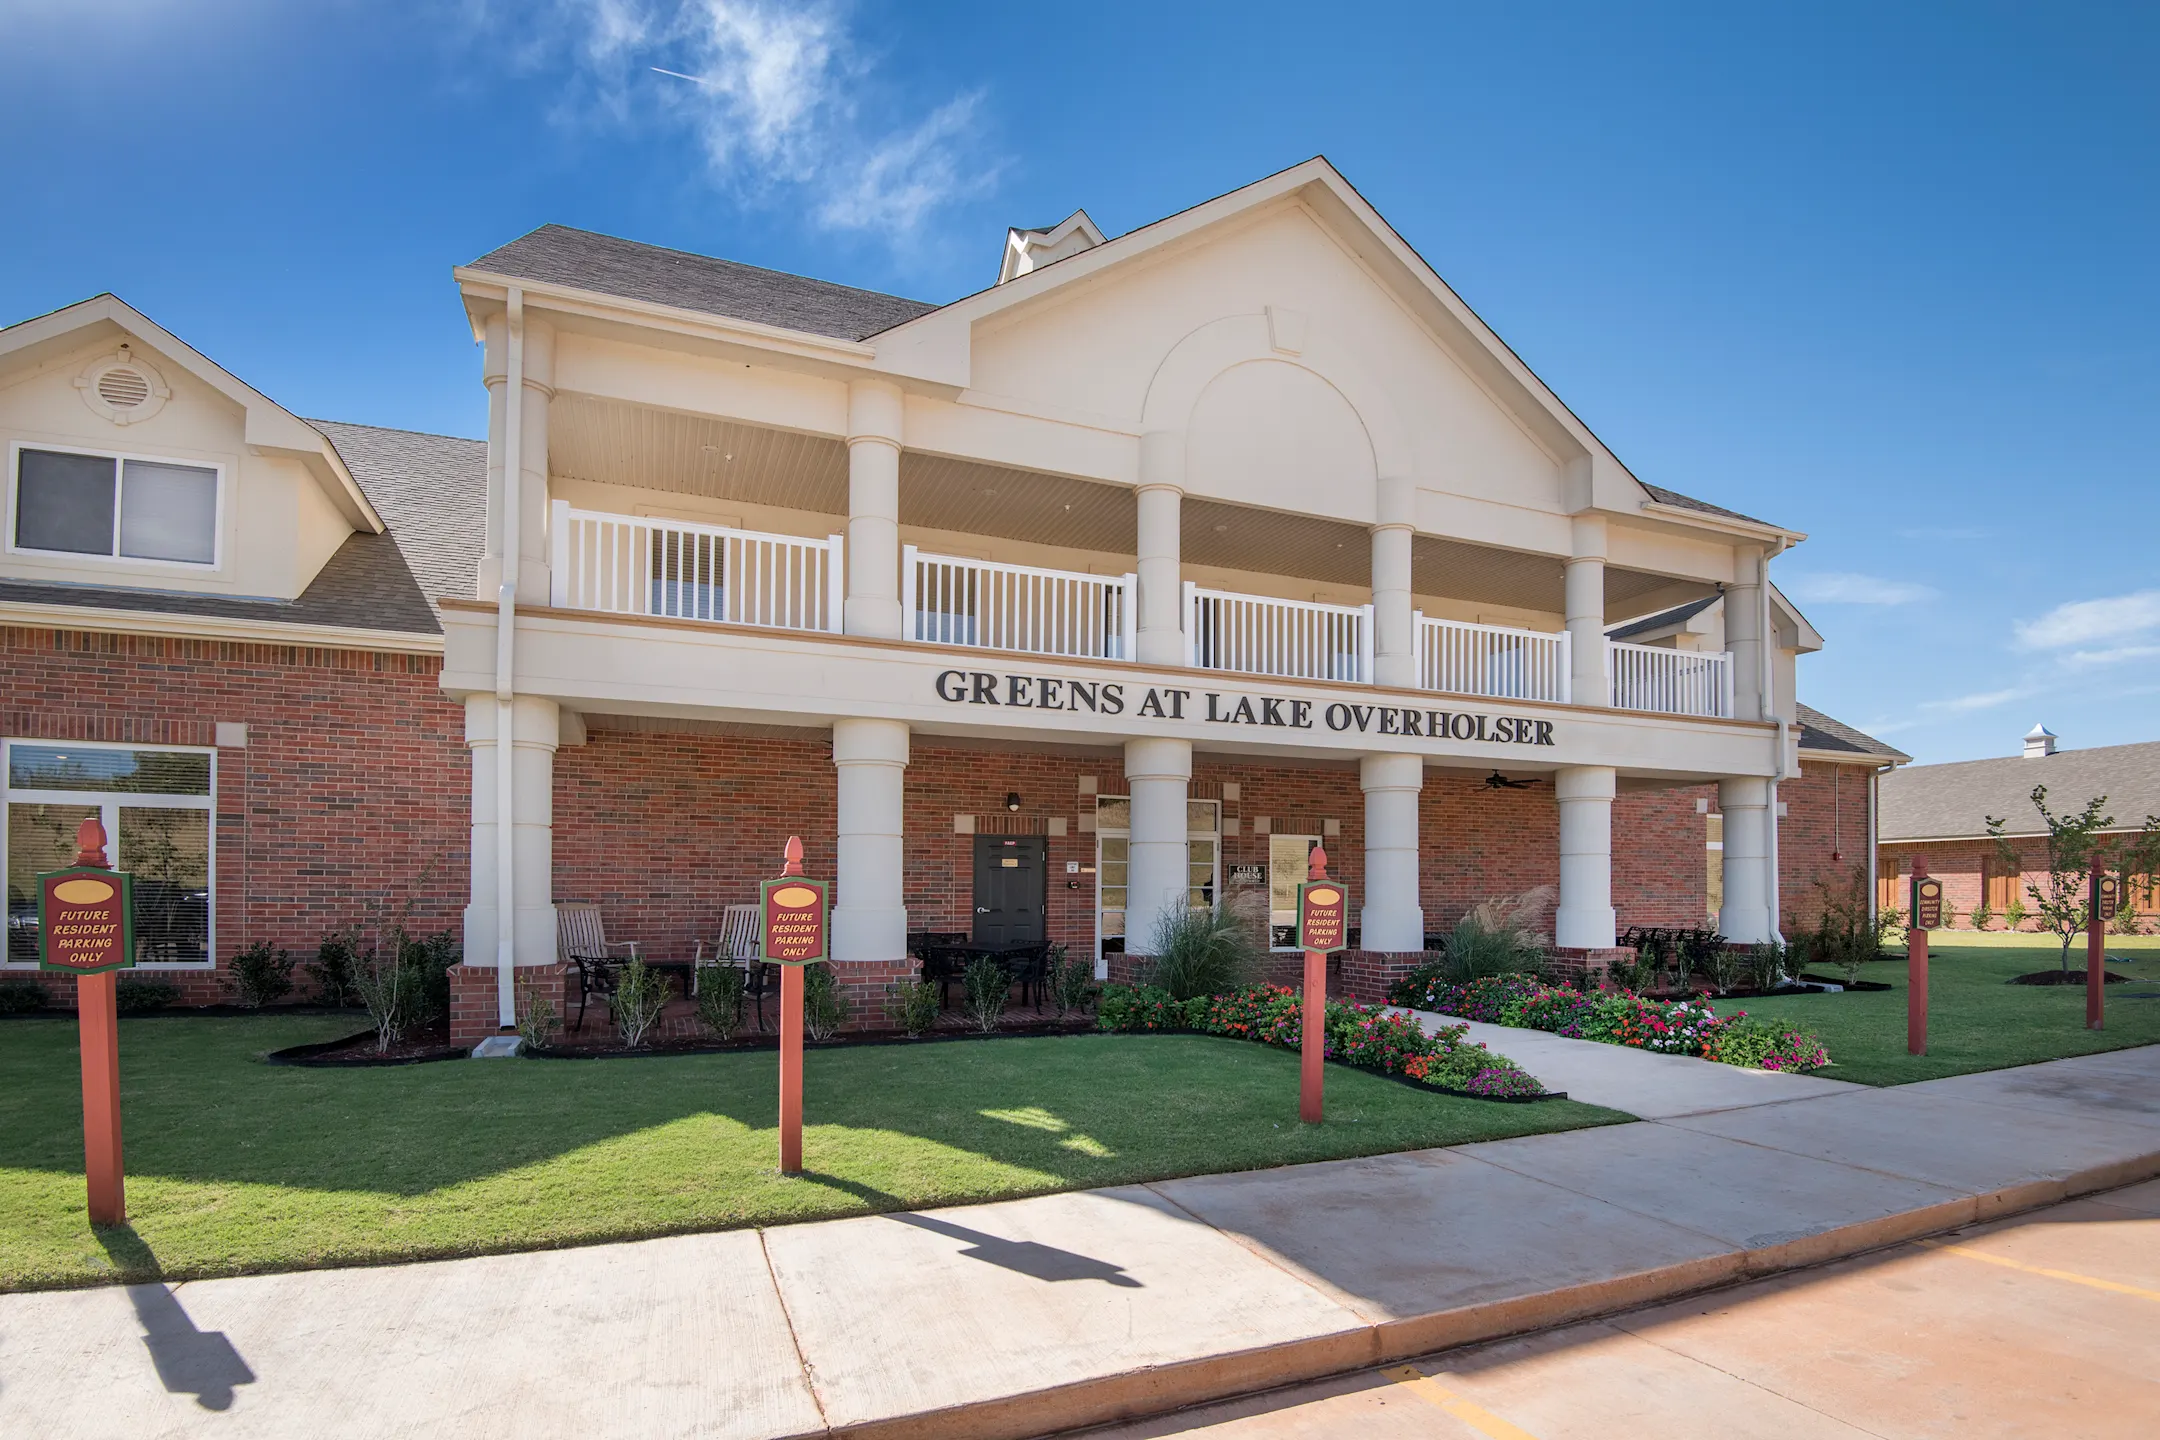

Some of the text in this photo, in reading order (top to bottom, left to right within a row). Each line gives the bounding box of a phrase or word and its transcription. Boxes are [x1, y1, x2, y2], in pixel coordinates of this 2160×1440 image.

[936, 670, 1555, 746] GREENS AT LAKE OVERHOLSER
[59, 910, 110, 921] FUTURE
[776, 913, 814, 922] FUTURE
[1310, 909, 1337, 917] FUTURE
[53, 924, 117, 935] RESIDENT
[771, 924, 818, 933] RESIDENT
[58, 938, 113, 948] PARKING
[774, 936, 814, 945] PARKING
[782, 947, 808, 956] ONLY
[69, 952, 104, 963] ONLY
